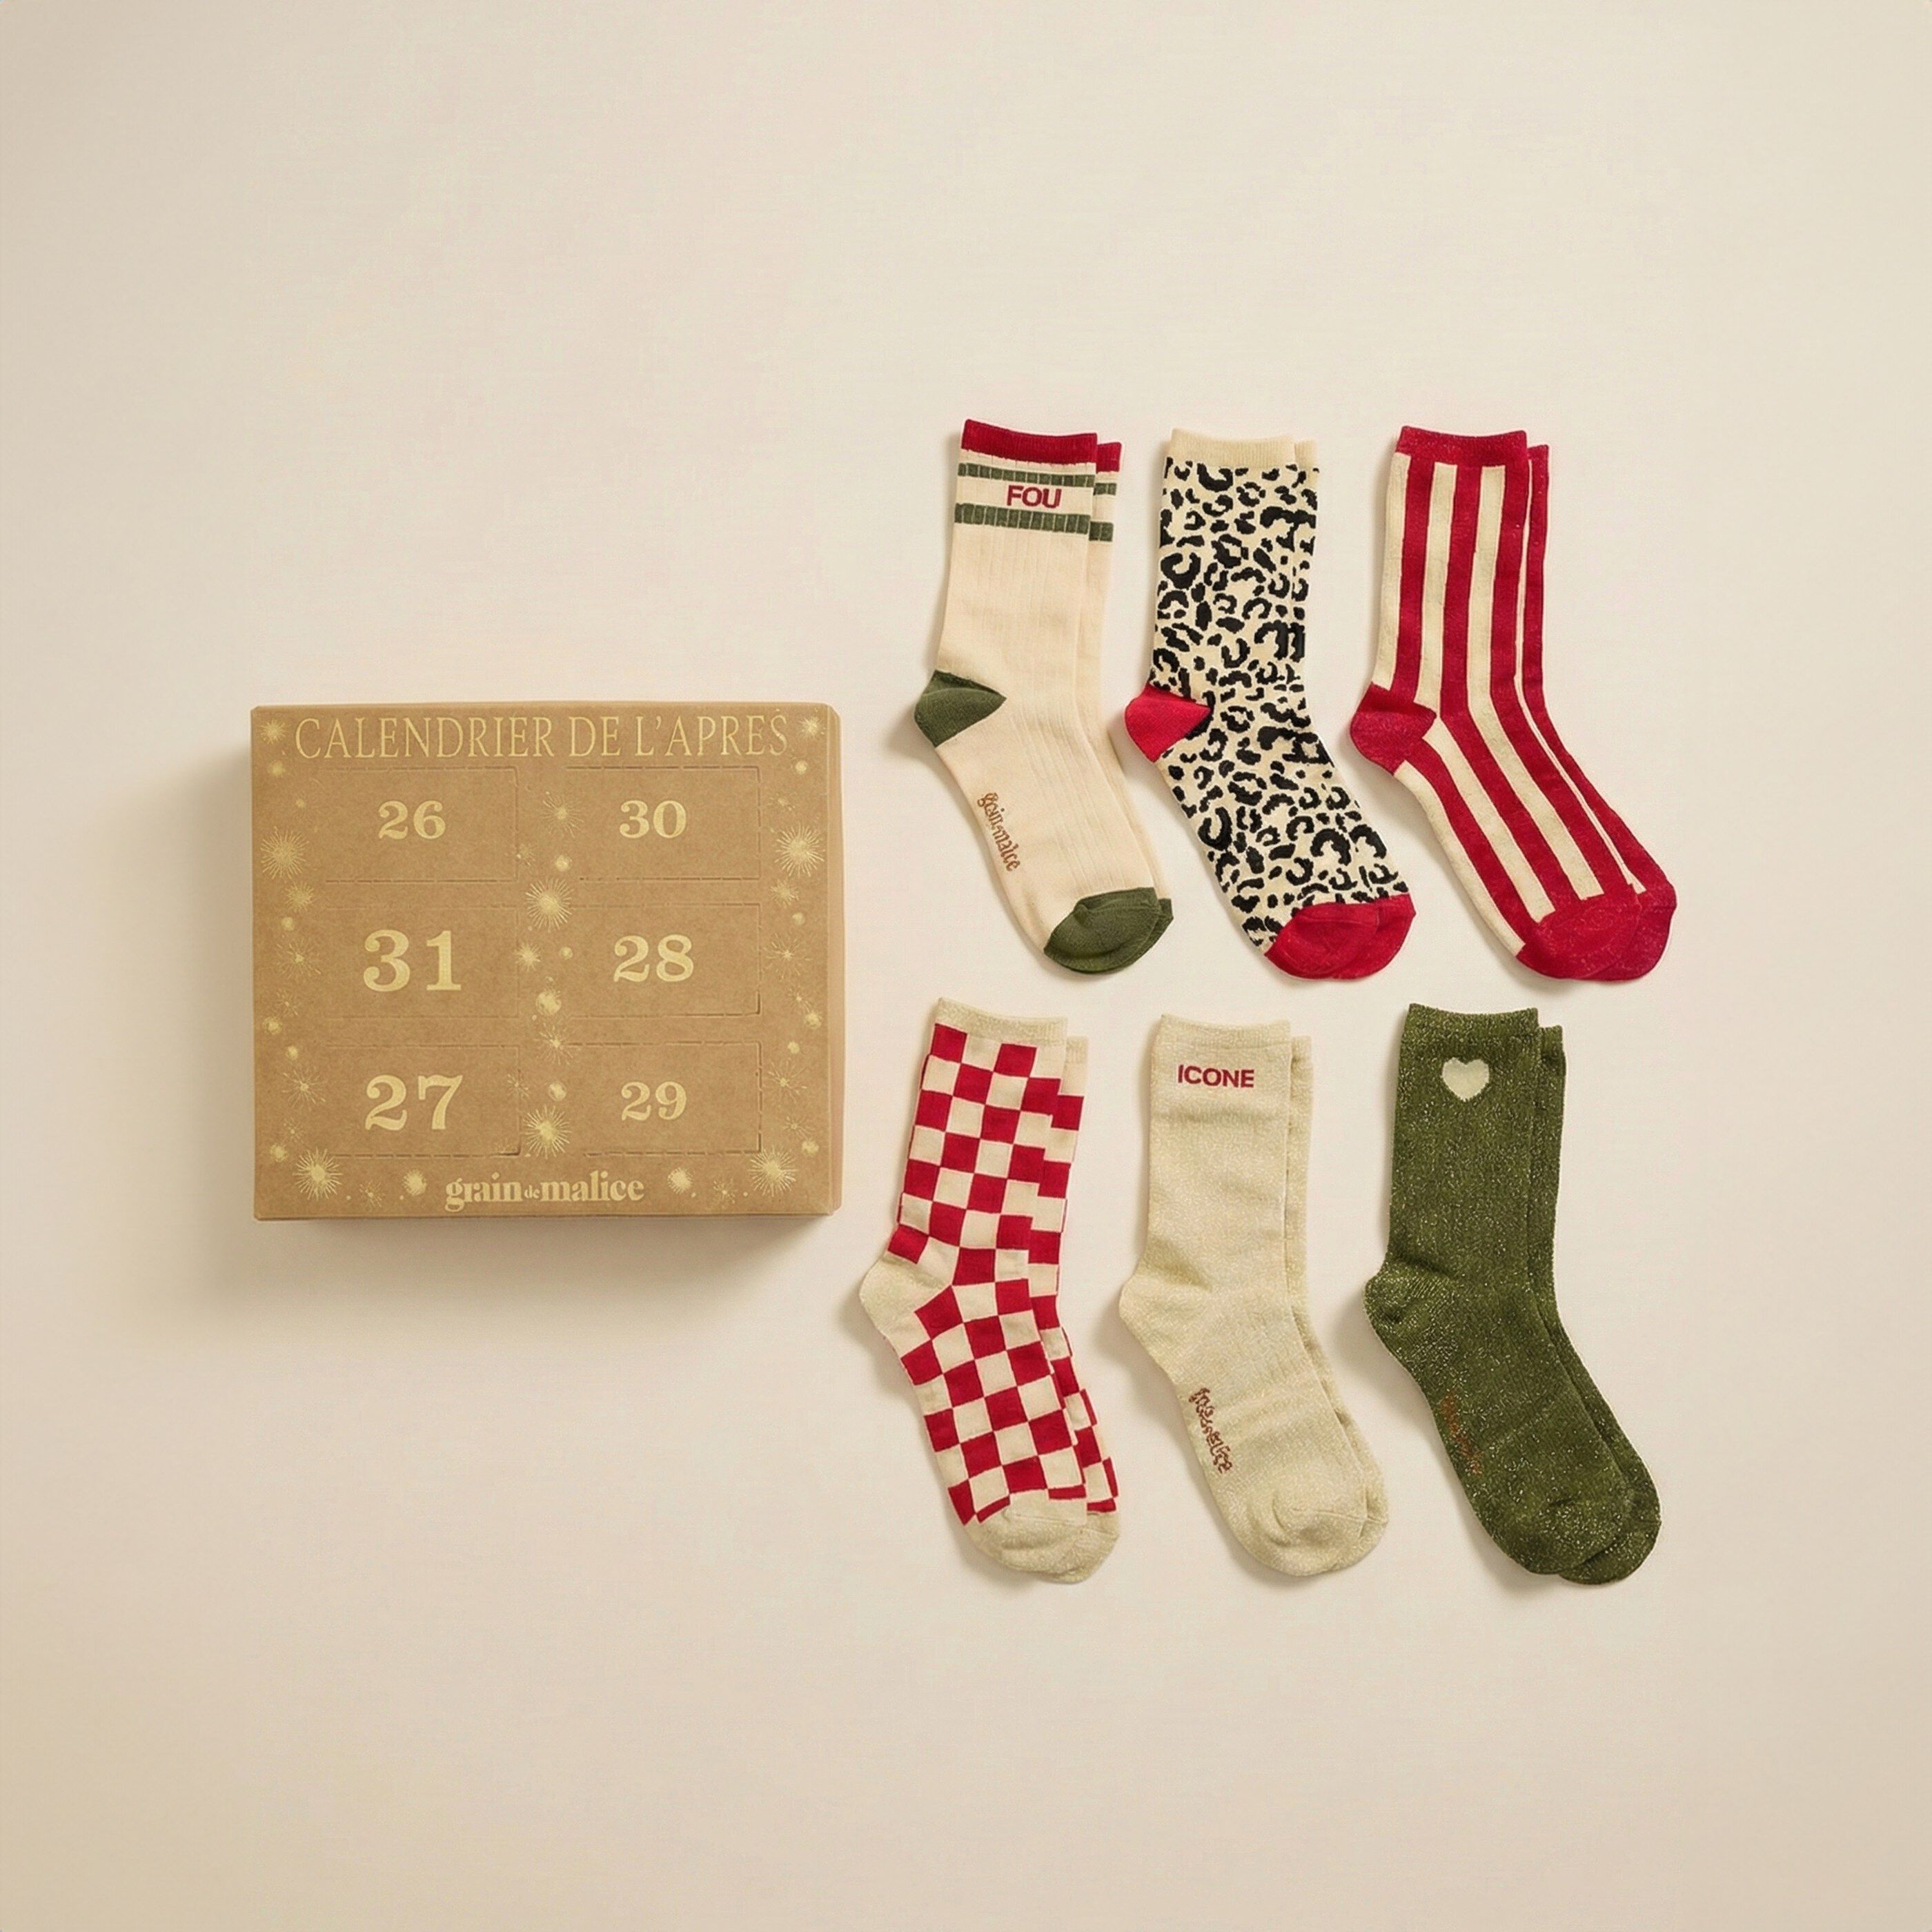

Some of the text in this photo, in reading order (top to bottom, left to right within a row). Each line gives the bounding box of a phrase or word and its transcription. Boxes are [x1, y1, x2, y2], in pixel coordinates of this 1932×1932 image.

[1005, 484, 1063, 509] FOU
[295, 716, 555, 759] CALENDRIER
[568, 716, 621, 758] DE
[378, 800, 446, 840] 26
[619, 800, 687, 839] 30
[363, 929, 462, 992] 31
[613, 934, 694, 983] 28
[1176, 1064, 1254, 1090] ICONE
[364, 1074, 464, 1131] 27
[620, 1081, 687, 1121] 29
